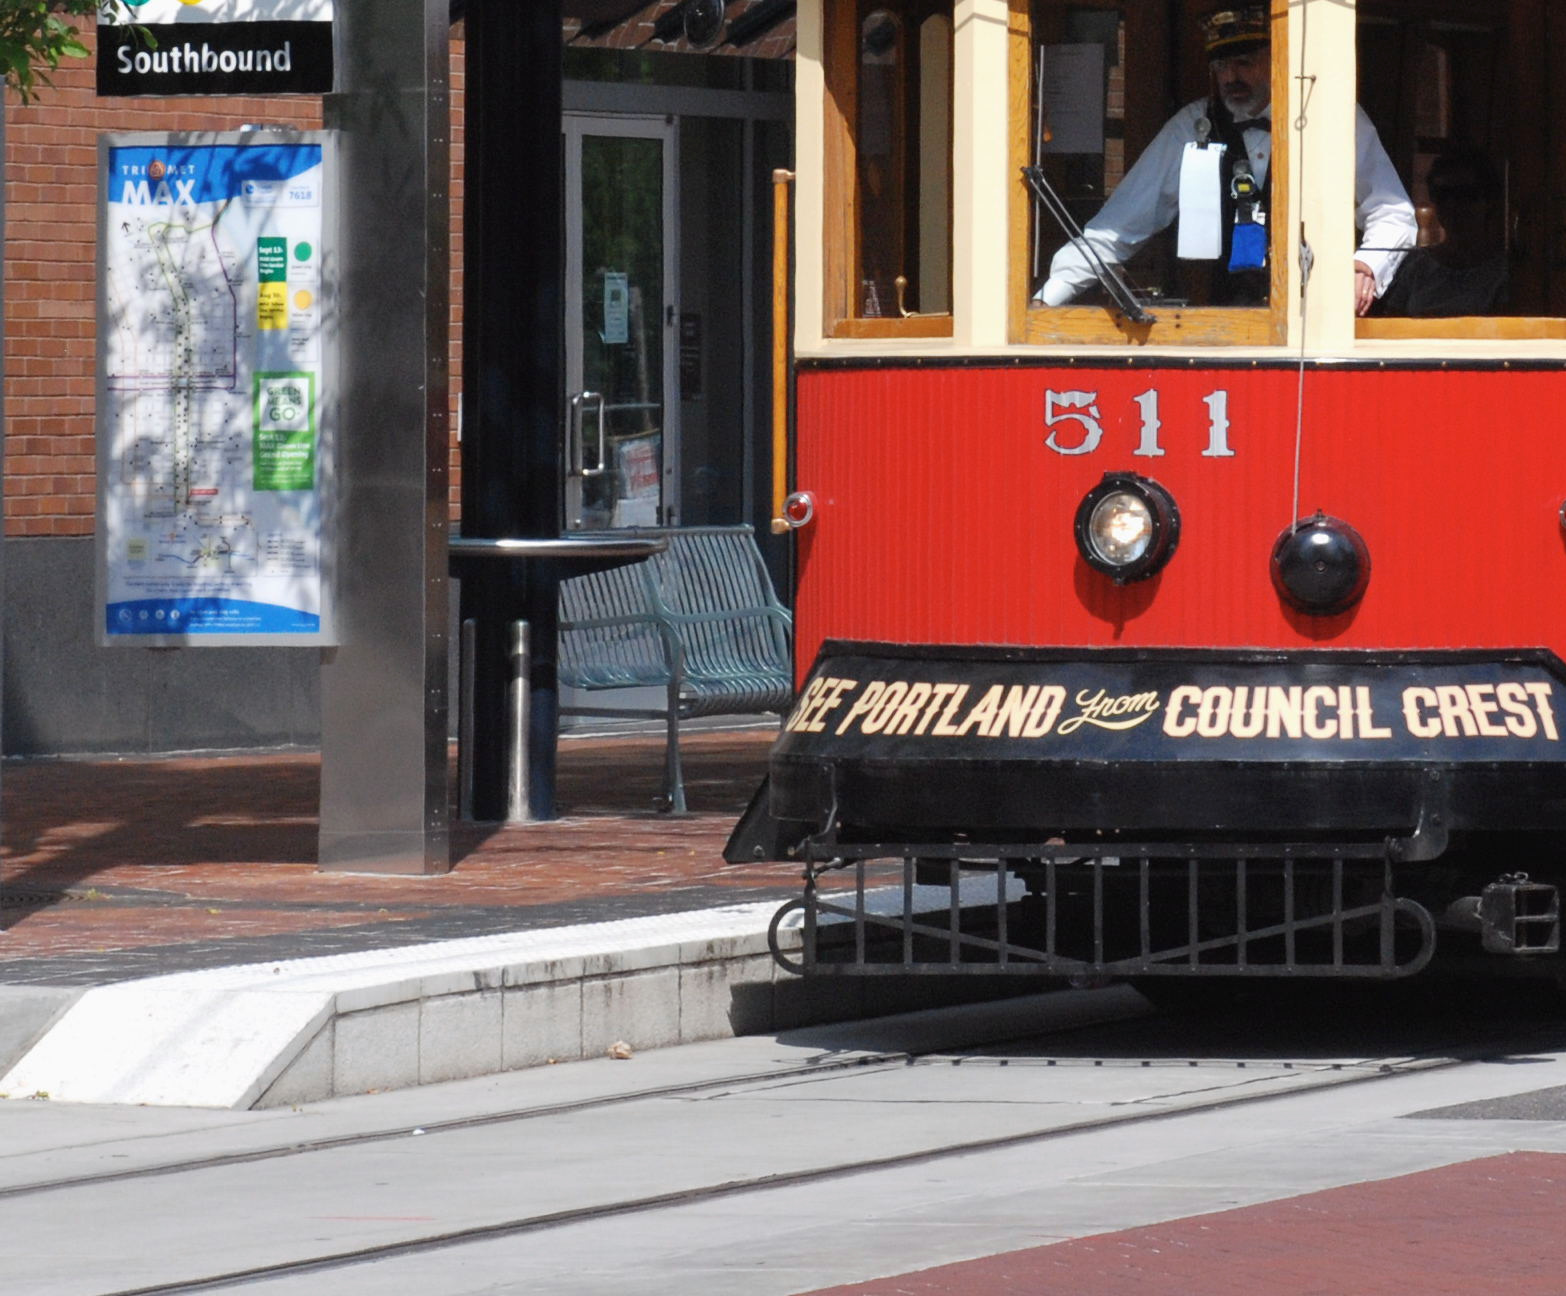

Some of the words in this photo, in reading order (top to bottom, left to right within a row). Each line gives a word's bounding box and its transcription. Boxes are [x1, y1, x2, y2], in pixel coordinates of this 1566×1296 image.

[116, 41, 291, 74] Southbound
[122, 164, 146, 176] TRI
[122, 179, 196, 209] MAX
[1044, 388, 1236, 458] 511
[785, 676, 857, 733] SEE
[835, 680, 1067, 738] PORTLAND
[1162, 684, 1392, 739] COUNCIL
[1402, 681, 1561, 741] CREST
